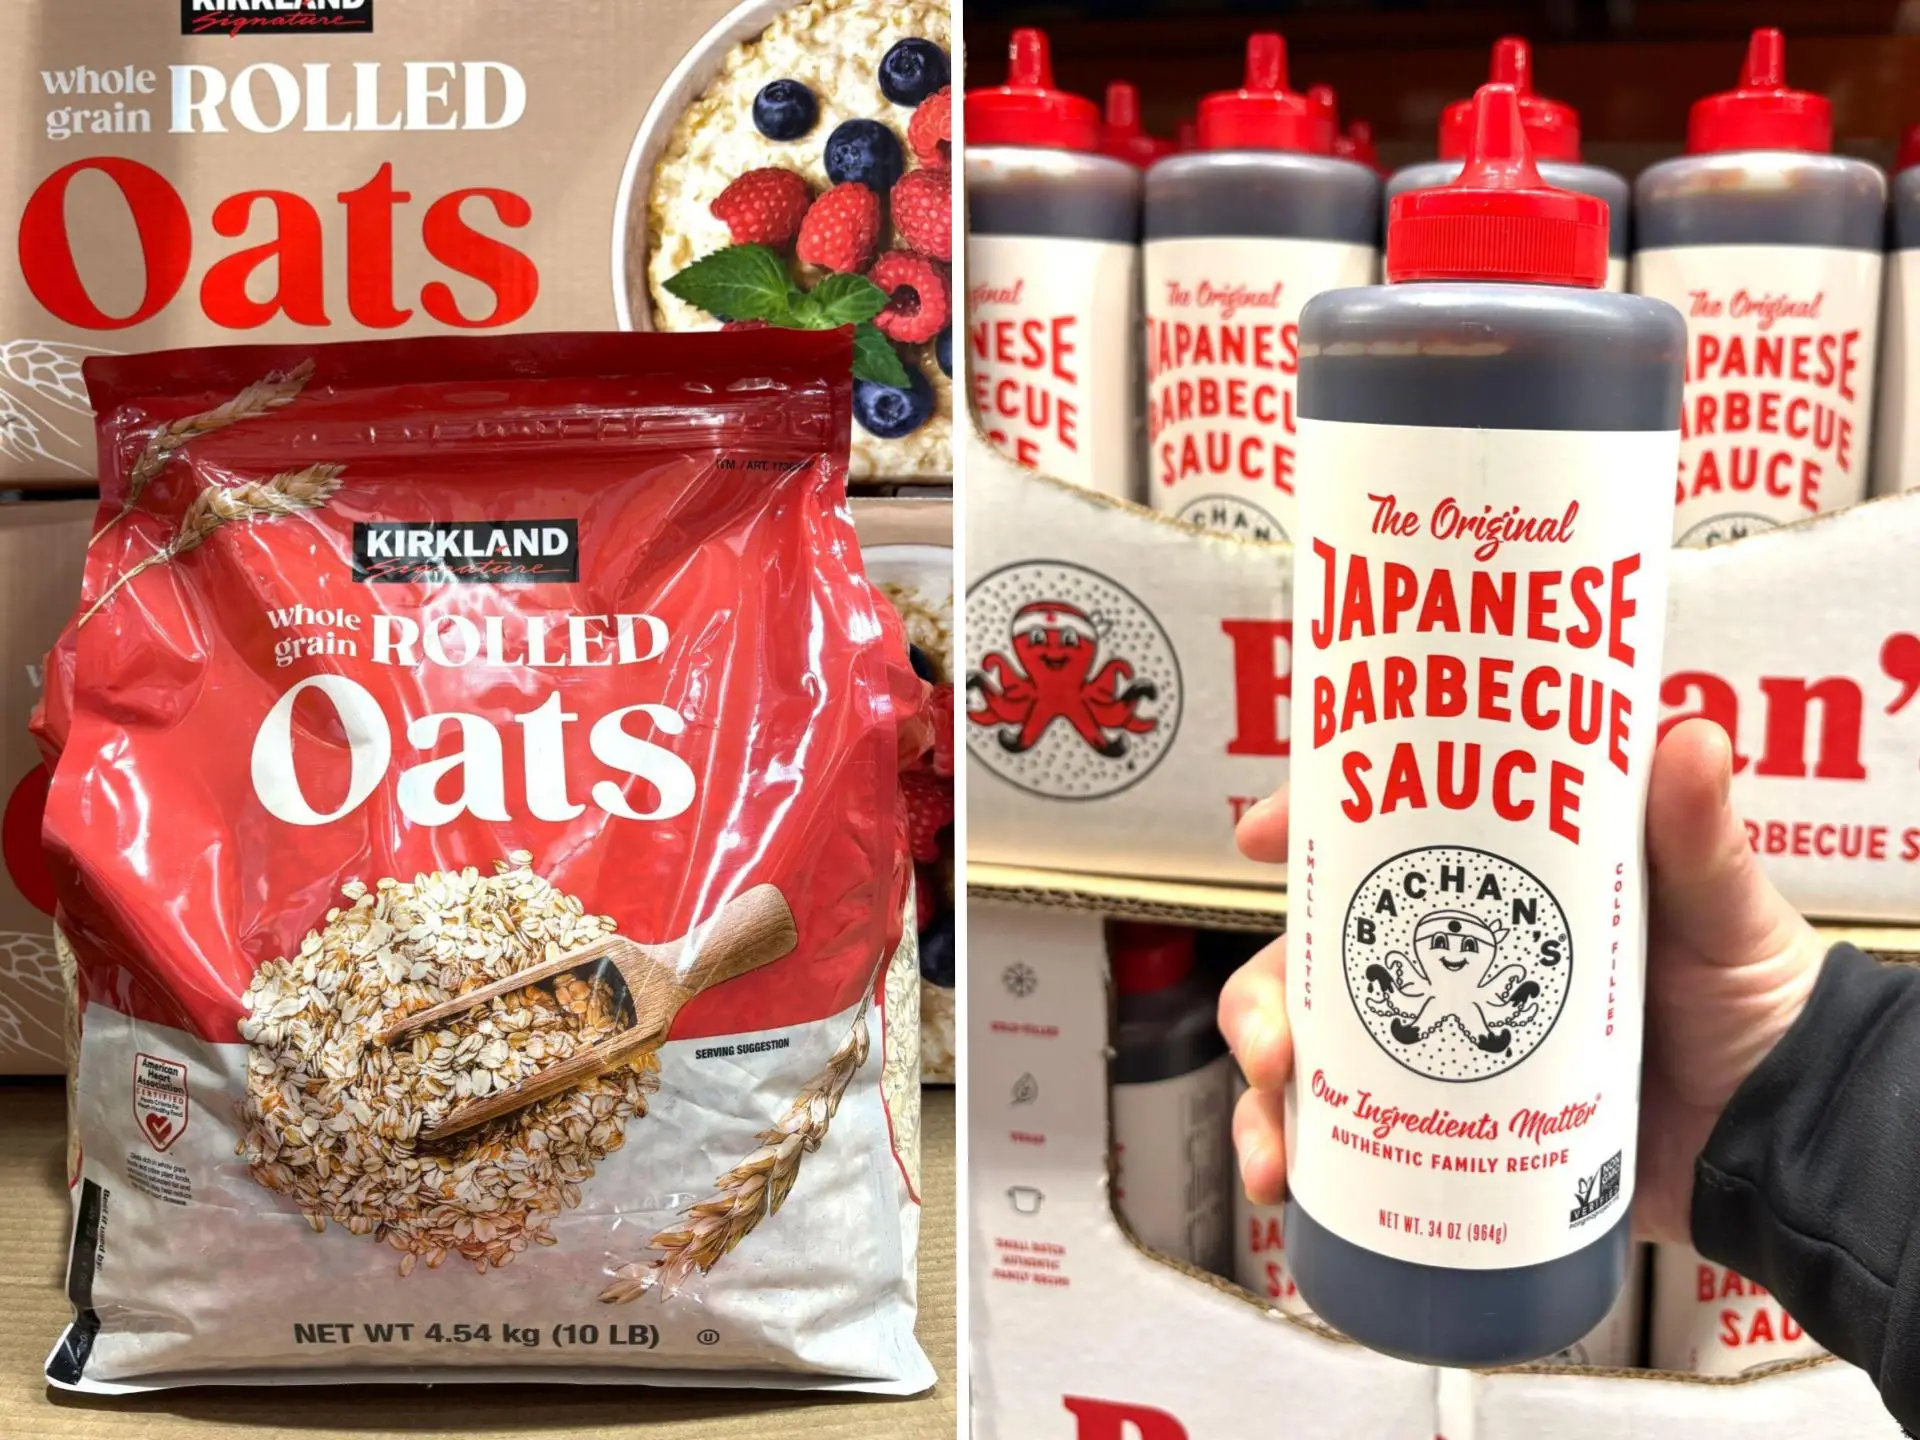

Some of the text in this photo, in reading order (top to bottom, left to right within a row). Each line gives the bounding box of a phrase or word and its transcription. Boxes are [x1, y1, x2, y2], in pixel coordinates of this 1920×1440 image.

[192, 11, 366, 38] Signature
[40, 64, 156, 95] whole
[167, 61, 527, 134] ROLLED
[46, 102, 151, 141] grain
[18, 156, 539, 330] Oats
[1197, 279, 1283, 318] Original
[1688, 288, 1825, 330] The Original
[1162, 430, 1297, 497] SAUCE
[367, 527, 569, 558] KIRKLAND
[1367, 493, 1580, 562] The Original
[365, 558, 570, 583] Signature
[266, 603, 361, 631] whole
[1311, 536, 1641, 669] JAPANESE
[274, 632, 357, 665] grain
[371, 613, 671, 667] ROLLED
[1313, 654, 1633, 776] BARBECUE
[251, 674, 697, 827] Oats
[1340, 740, 1585, 846] SAUCE
[142, 1058, 179, 1076] American
[695, 1037, 790, 1060] SERVING SUGGESTION
[137, 1075, 185, 1094] Association
[148, 1070, 171, 1083] Heart
[1312, 1069, 1348, 1107] Our
[1352, 1089, 1499, 1140] Ingredients
[1331, 1125, 1570, 1173] AUTHENTIC FAMILY RECIPE
[1378, 1209, 1509, 1246] NET WT. 34 OZ (964g)
[294, 1323, 354, 1346] NET
[364, 1323, 415, 1343] WT
[425, 1322, 492, 1344] 4.54
[502, 1322, 541, 1349] kg
[551, 1323, 600, 1349] (10
[610, 1323, 661, 1349] LB)
